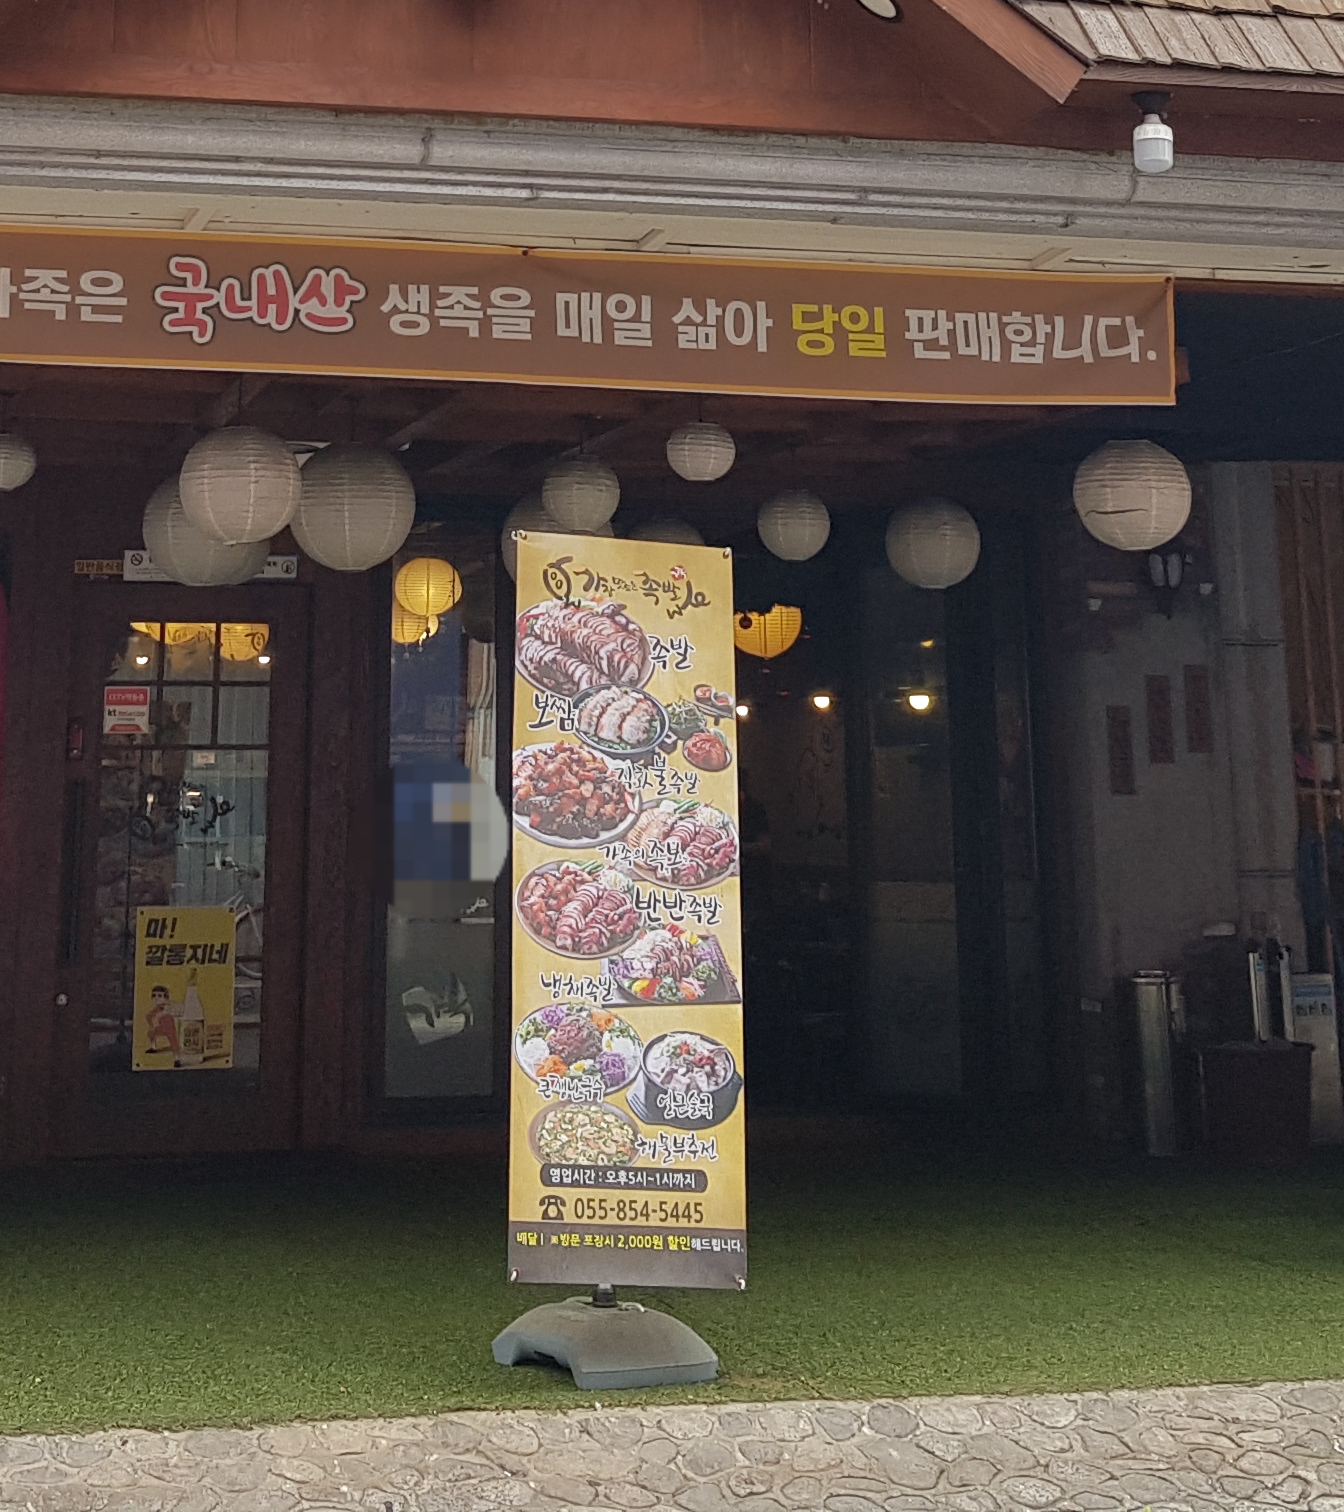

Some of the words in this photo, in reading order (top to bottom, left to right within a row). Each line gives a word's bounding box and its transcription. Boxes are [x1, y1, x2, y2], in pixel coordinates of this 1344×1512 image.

[156, 256, 367, 344] 국내산
[379, 281, 535, 341] 생족을
[555, 291, 653, 348] 매일
[671, 297, 773, 354] 삶아
[791, 302, 887, 358] 당일
[904, 307, 1157, 365] 판매합니다.
[647, 634, 695, 670] 족발
[528, 692, 575, 732] 보쌈
[635, 886, 723, 925] 반반족발
[144, 916, 177, 939] 마!
[540, 972, 615, 1003] 냉채족발
[636, 1132, 718, 1164] 해물부추전
[549, 1168, 596, 1185] 영업시간
[574, 1197, 704, 1224] 055-854-5445
[617, 1234, 664, 1250] 2,000원
